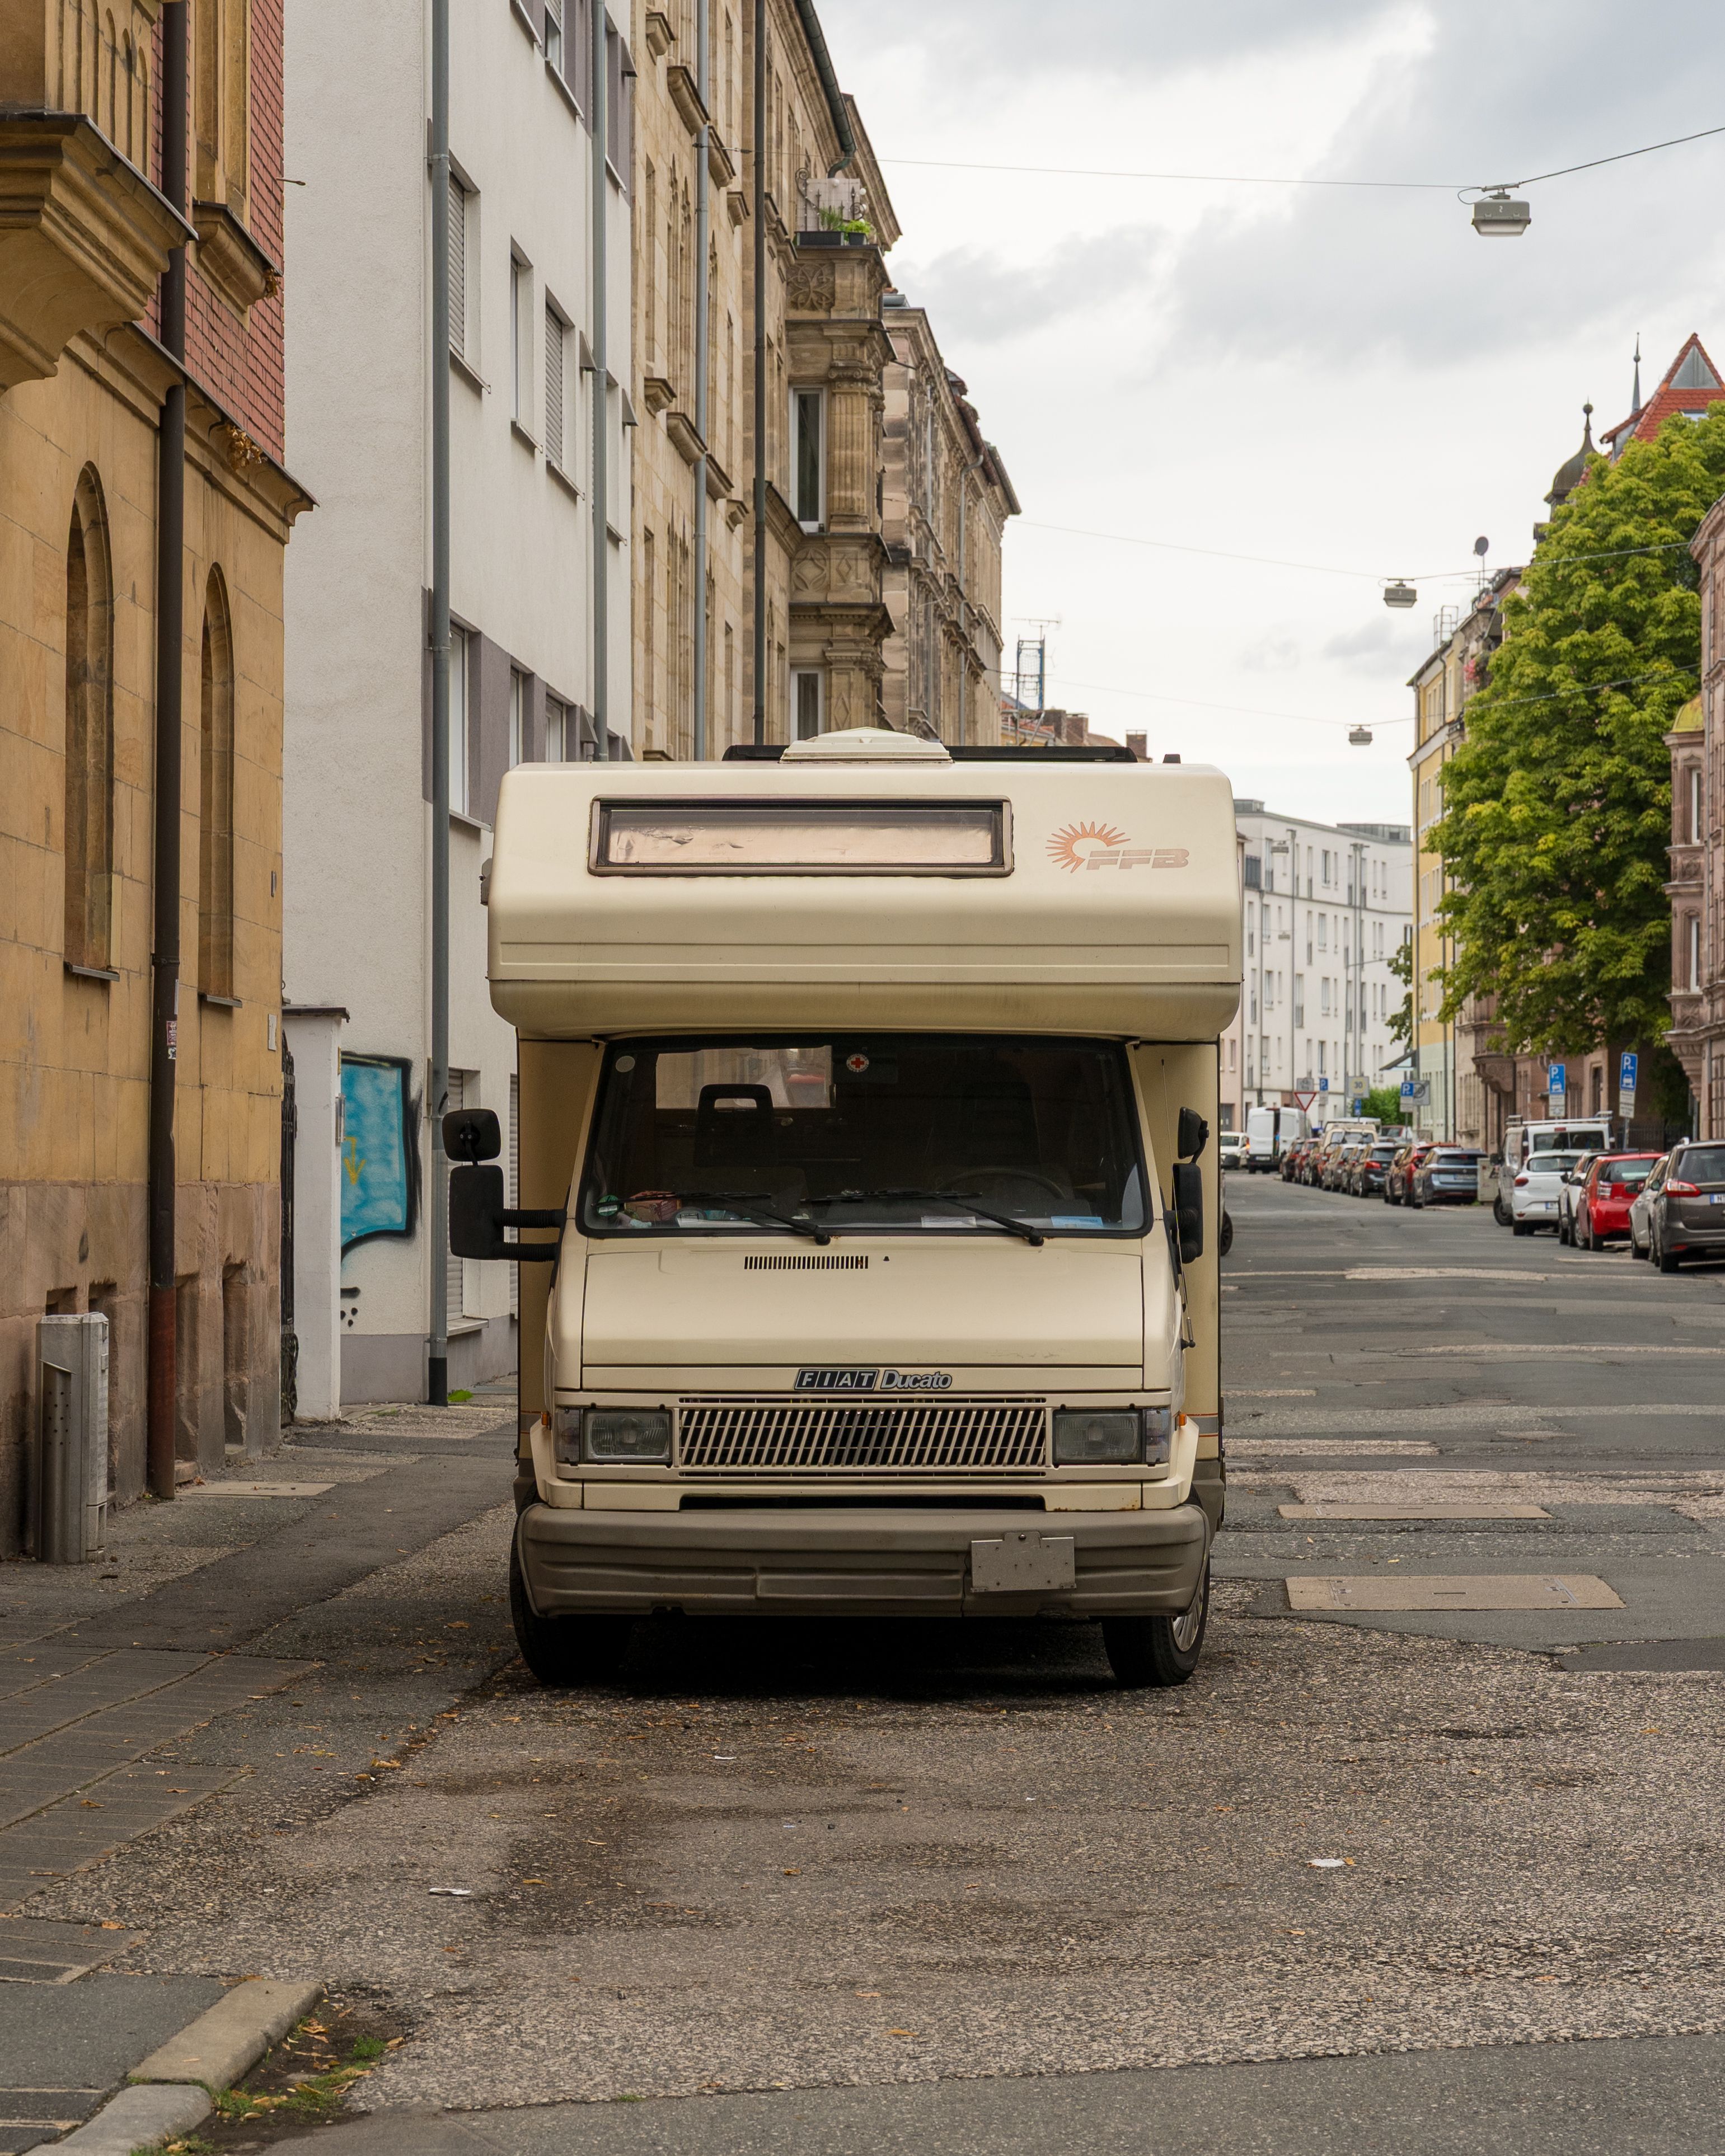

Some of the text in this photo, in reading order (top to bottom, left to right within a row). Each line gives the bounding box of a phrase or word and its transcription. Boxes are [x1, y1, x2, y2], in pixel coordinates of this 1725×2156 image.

[1086, 849, 1189, 870] FFB
[1624, 1056, 1631, 1070] P
[1551, 1067, 1558, 1079] P
[1401, 1083, 1409, 1095] P
[802, 1370, 951, 1389] FIAT Ducato
